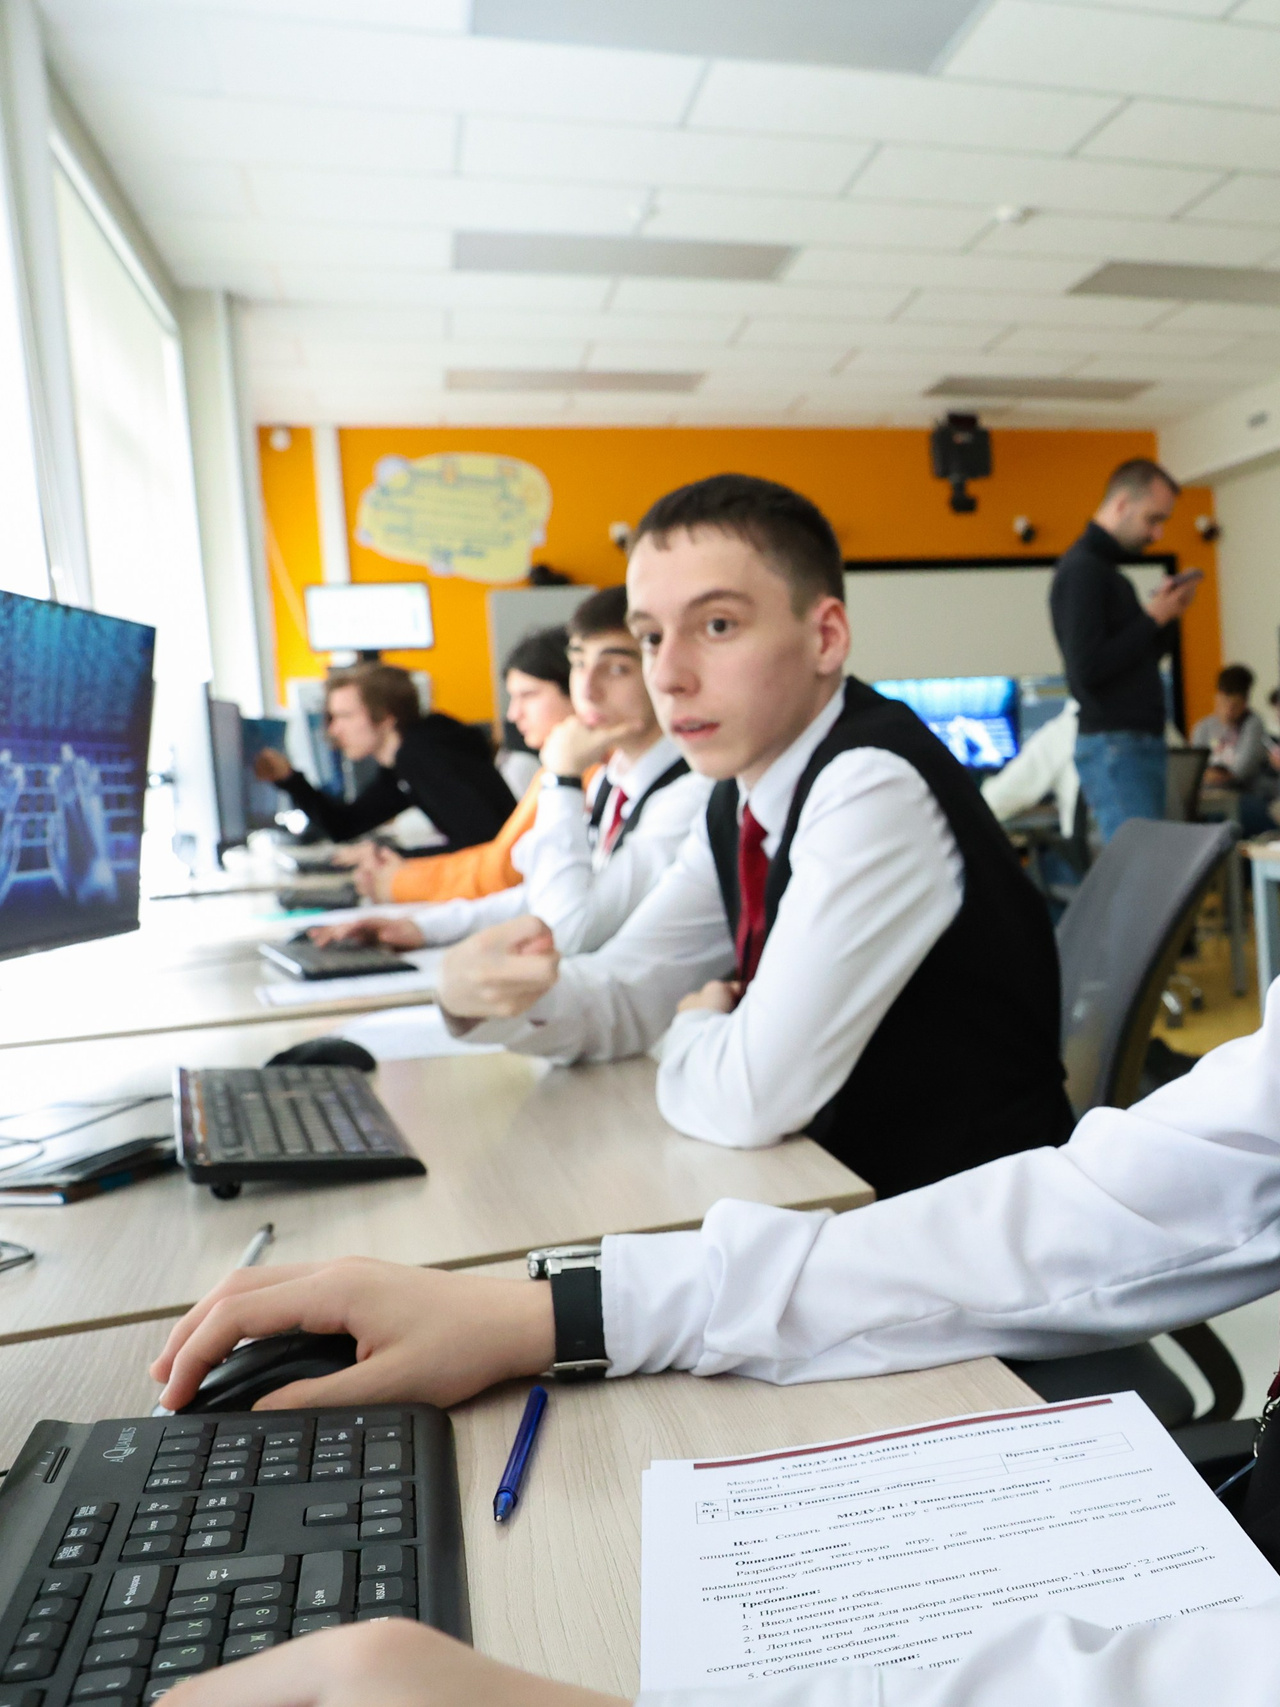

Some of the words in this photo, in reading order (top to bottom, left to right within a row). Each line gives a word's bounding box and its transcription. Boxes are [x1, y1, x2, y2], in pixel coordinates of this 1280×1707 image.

[836, 1505, 895, 1519] МОДУЛЬ
[913, 1488, 996, 1505] Таинственный
[999, 1479, 1051, 1492] лабиринт
[125, 1574, 141, 1597] Backspace
[713, 1591, 752, 1602] финал
[755, 1585, 788, 1595] игры.
[740, 1589, 821, 1609] Требования:
[759, 1597, 838, 1617] Приветствие
[851, 1582, 921, 1598] объяснение
[924, 1573, 966, 1585] правил
[968, 1567, 1001, 1577] игры.
[255, 1608, 270, 1616] Э
[757, 1630, 790, 1640] Ввод
[792, 1613, 875, 1634] пользователя
[902, 1600, 946, 1612] выбора
[948, 1587, 1004, 1604] действий
[1006, 1575, 1072, 1592] (например,
[760, 1618, 793, 1628] Ввод
[796, 1609, 835, 1621] имени
[838, 1601, 883, 1613] игрока.
[706, 1648, 823, 1674] соответствующие
[826, 1633, 900, 1652] сообщения.
[762, 1658, 838, 1677] Сообщение
[853, 1637, 938, 1660] прохождение
[941, 1630, 973, 1640] игры
